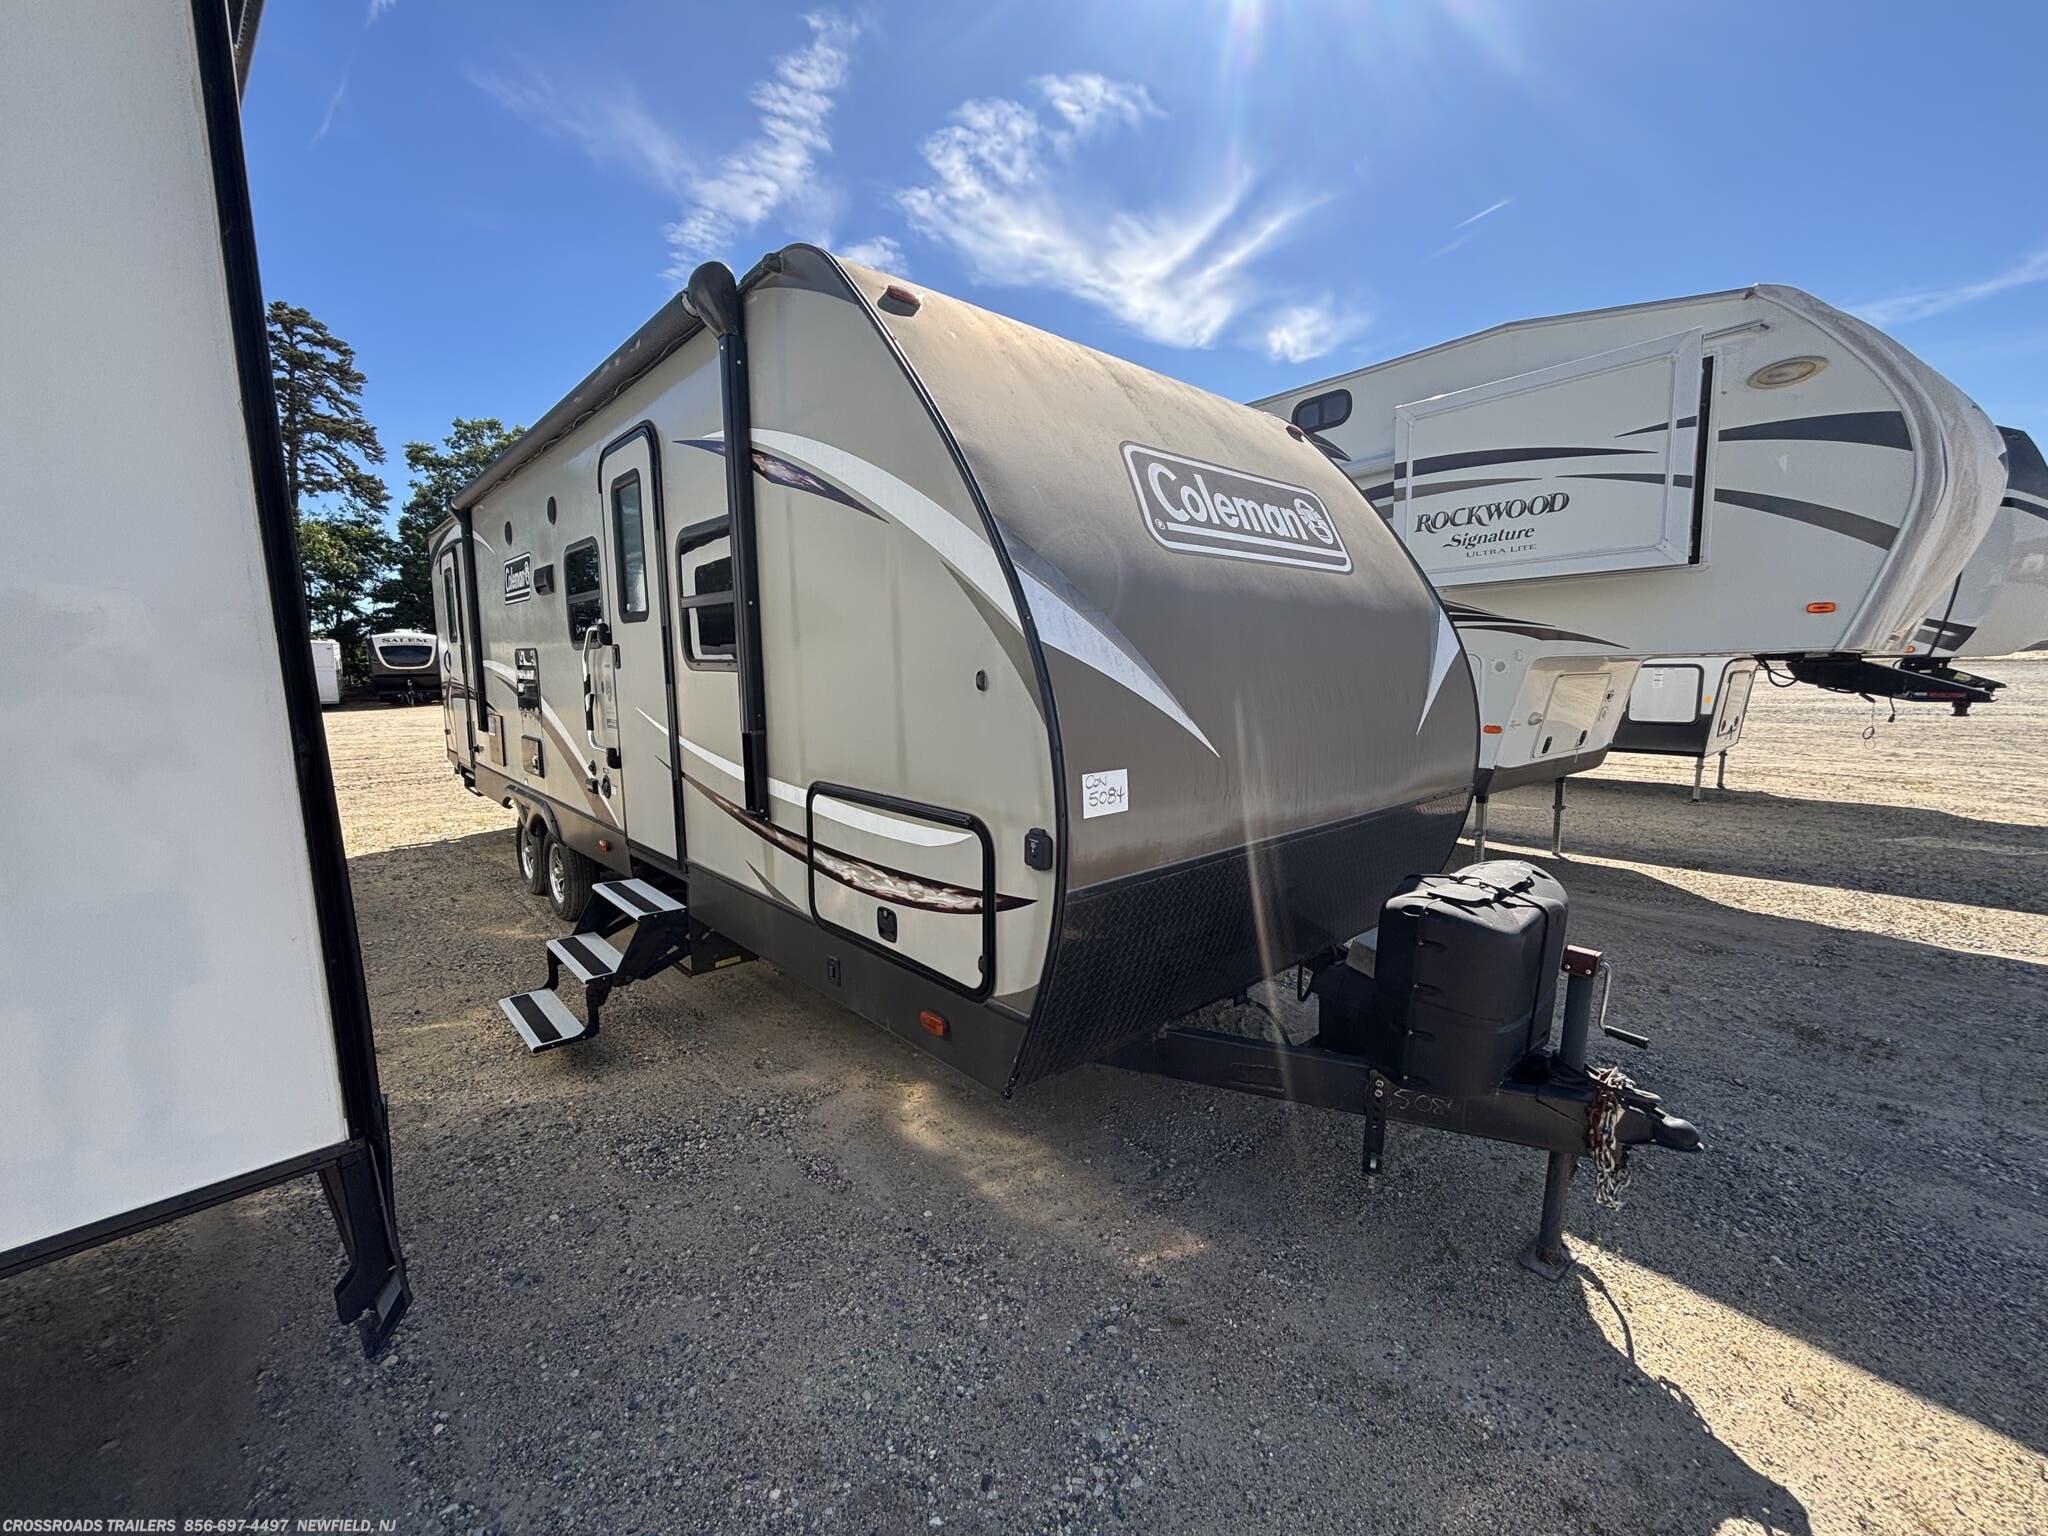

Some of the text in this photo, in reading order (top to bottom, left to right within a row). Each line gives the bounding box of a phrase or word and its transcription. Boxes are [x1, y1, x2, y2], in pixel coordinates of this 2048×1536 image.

[1147, 462, 1309, 541] Coleman
[1415, 492, 1570, 534] ROCKWOOD
[1442, 526, 1535, 550] Signature
[1466, 543, 1536, 558] ULTRA LITE
[505, 568, 525, 592] Coleman
[1089, 787, 1124, 806] 5084
